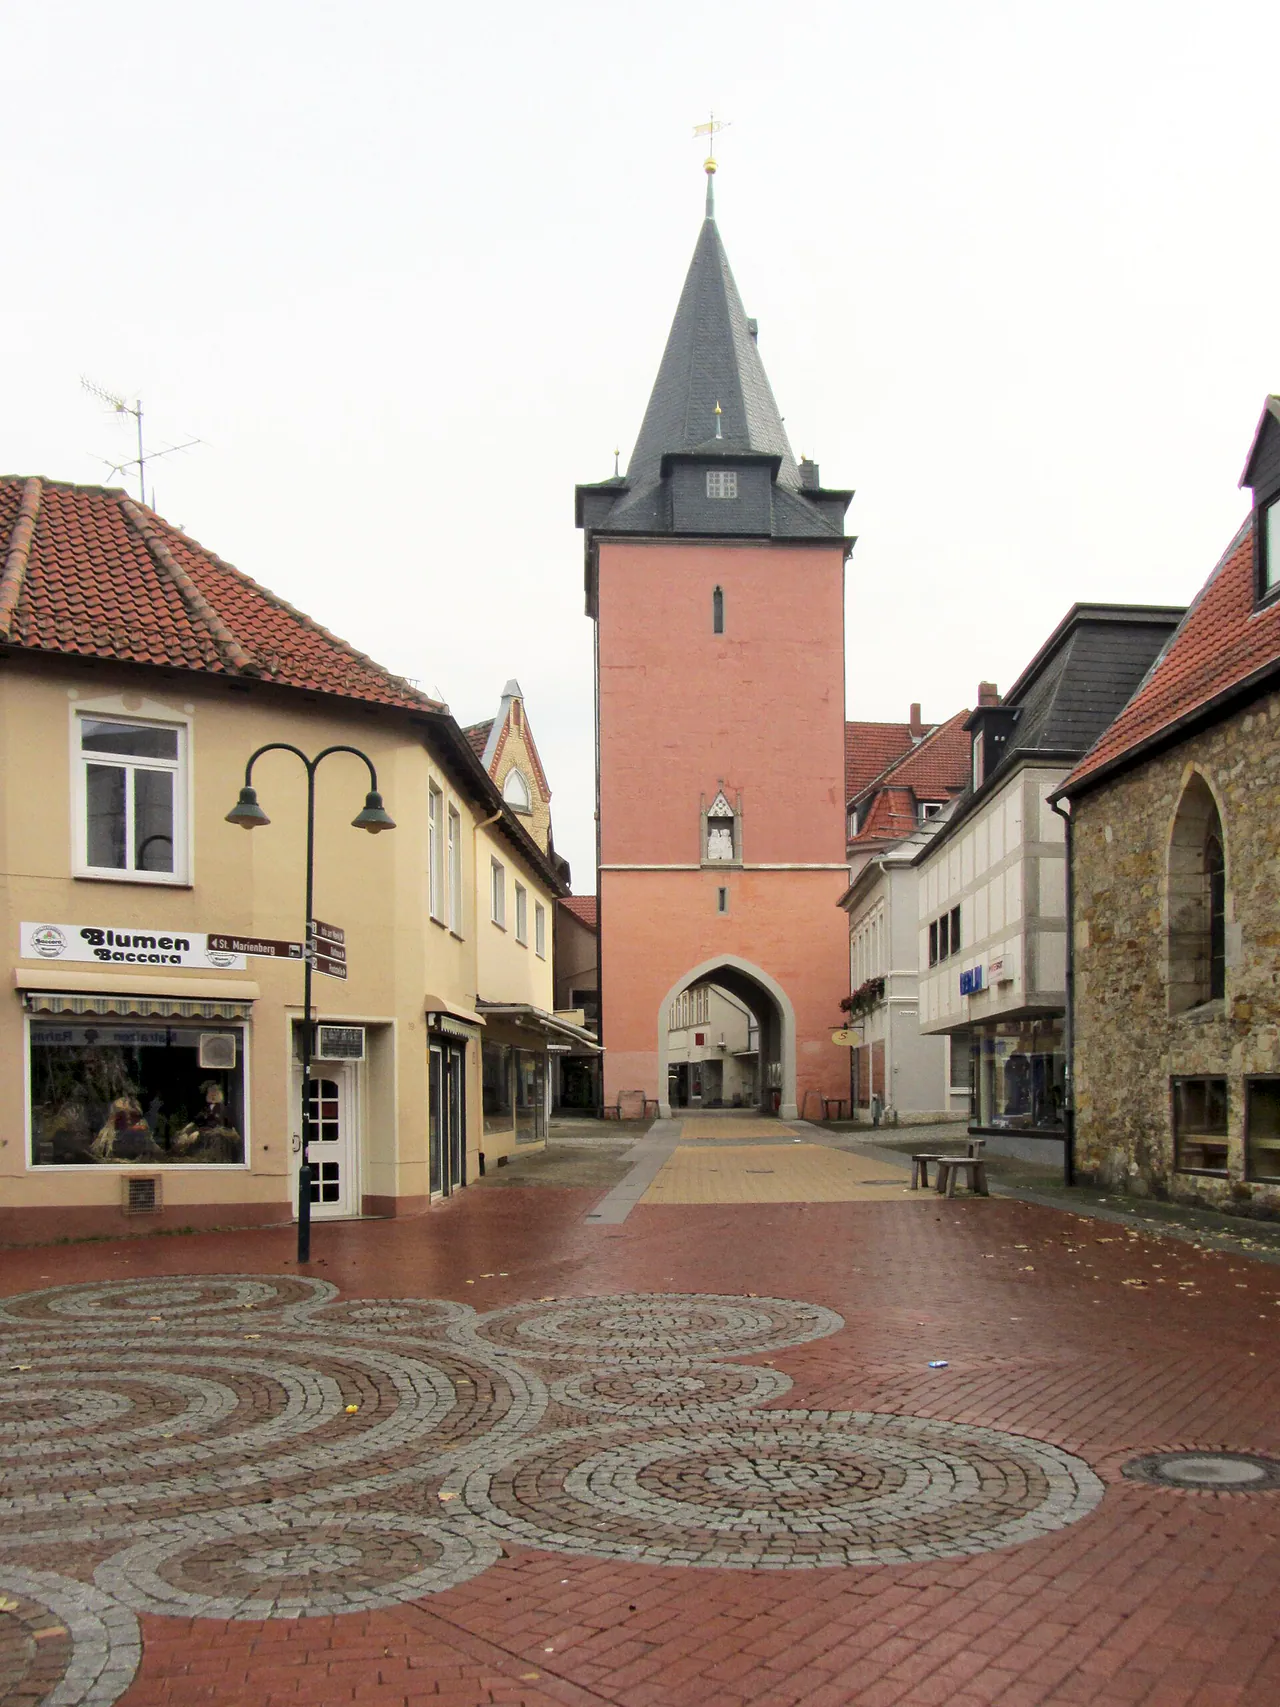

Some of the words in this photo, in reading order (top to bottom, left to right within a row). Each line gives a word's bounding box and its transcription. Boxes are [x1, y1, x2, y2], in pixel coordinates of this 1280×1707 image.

[80, 928, 190, 951] Blumen
[219, 939, 230, 950] St.
[232, 940, 276, 956] Marienberg
[93, 948, 182, 965] Baccara
